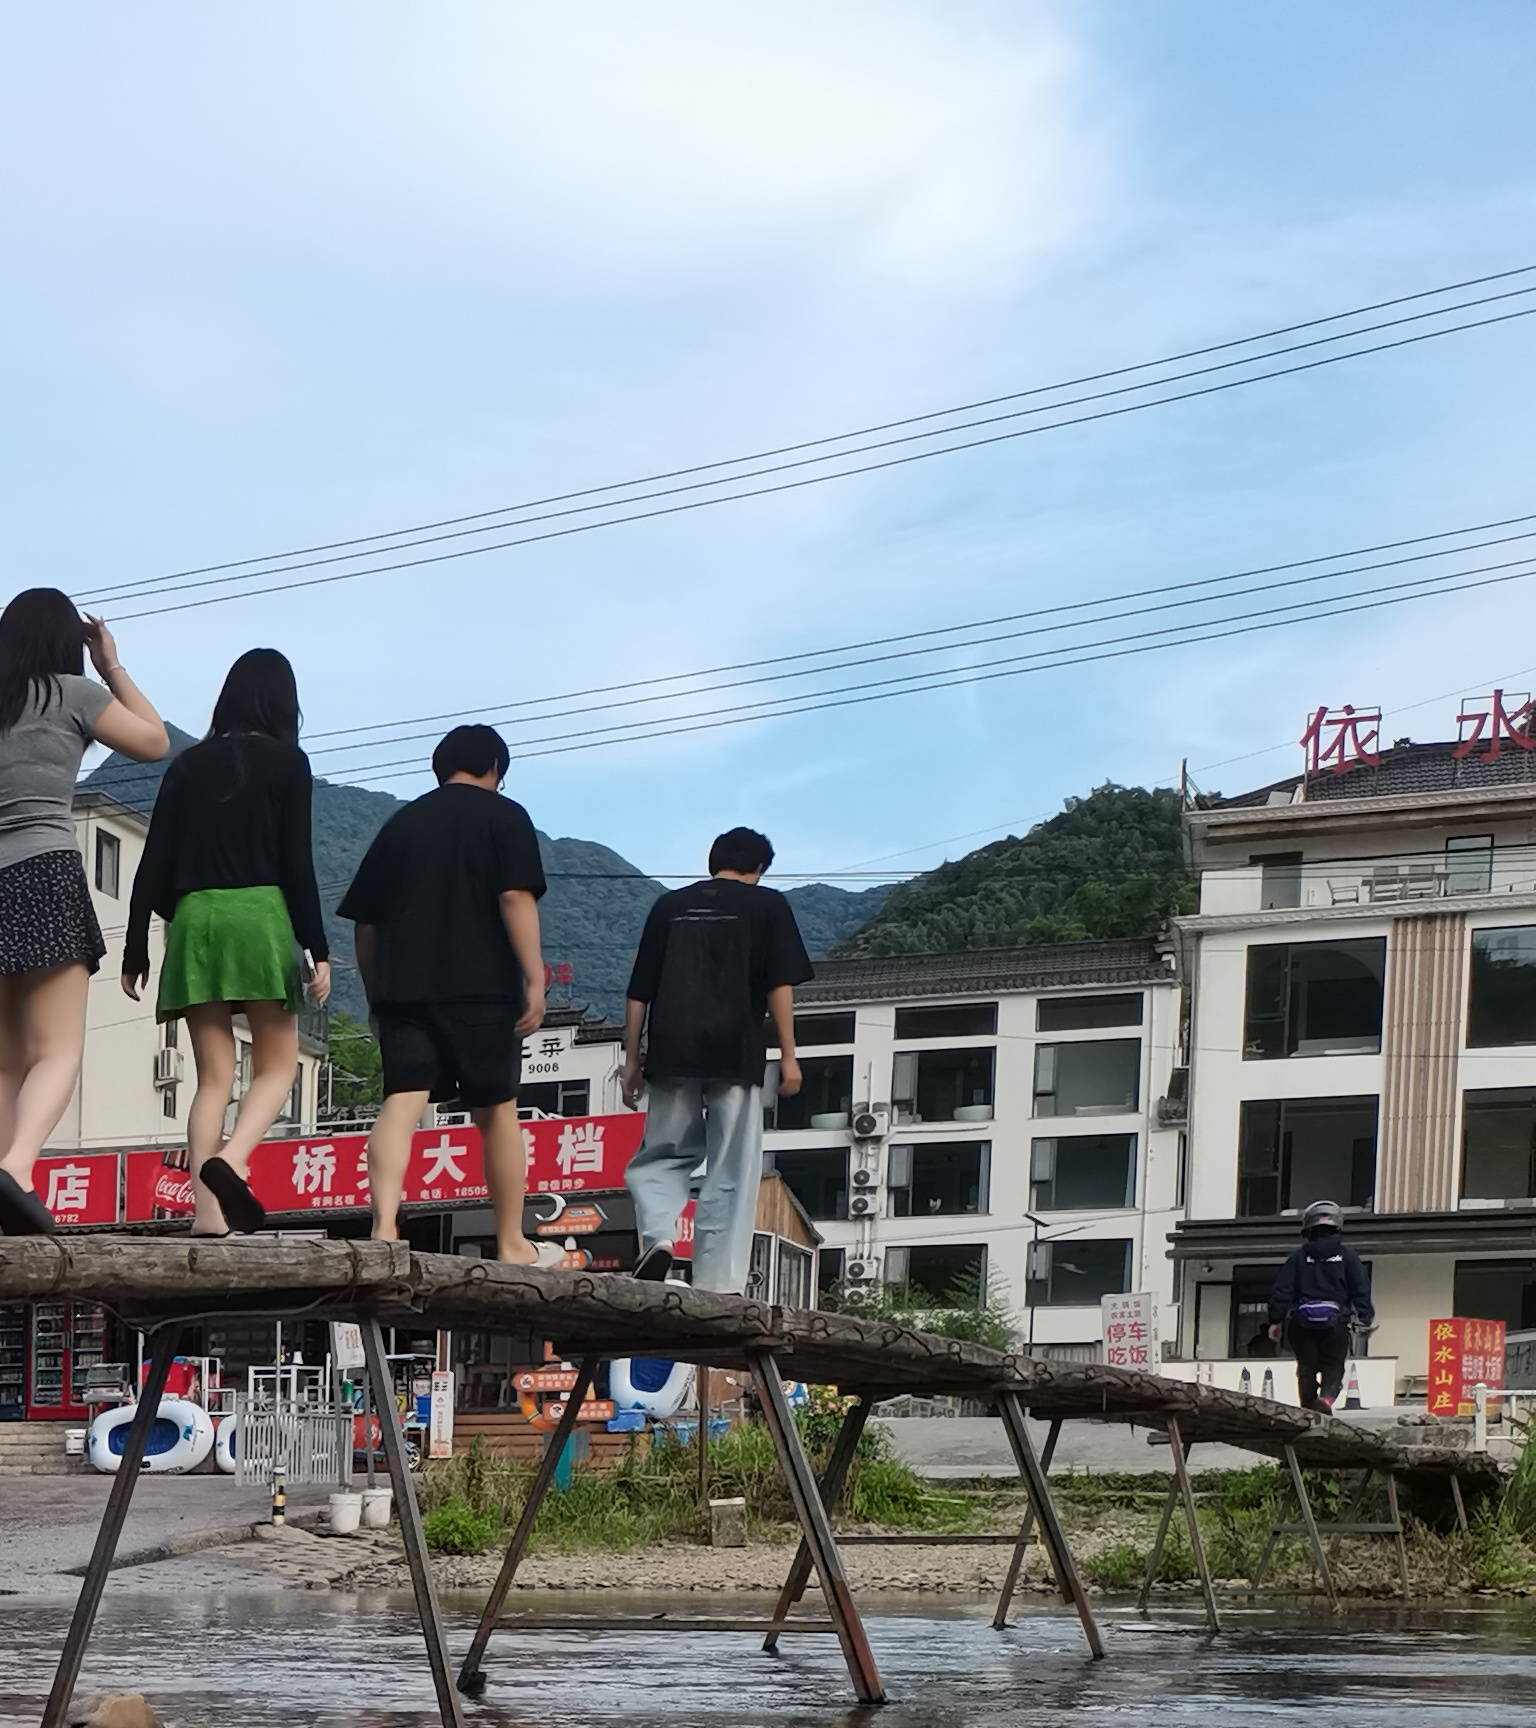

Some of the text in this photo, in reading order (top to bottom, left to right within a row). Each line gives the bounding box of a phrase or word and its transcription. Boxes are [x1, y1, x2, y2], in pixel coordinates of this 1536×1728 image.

[1299, 689, 1536, 776] 依水
[1107, 1321, 1148, 1343] 停车
[1107, 1345, 1148, 1366] 吃饭
[1433, 1322, 1458, 1410] 依水山庄
